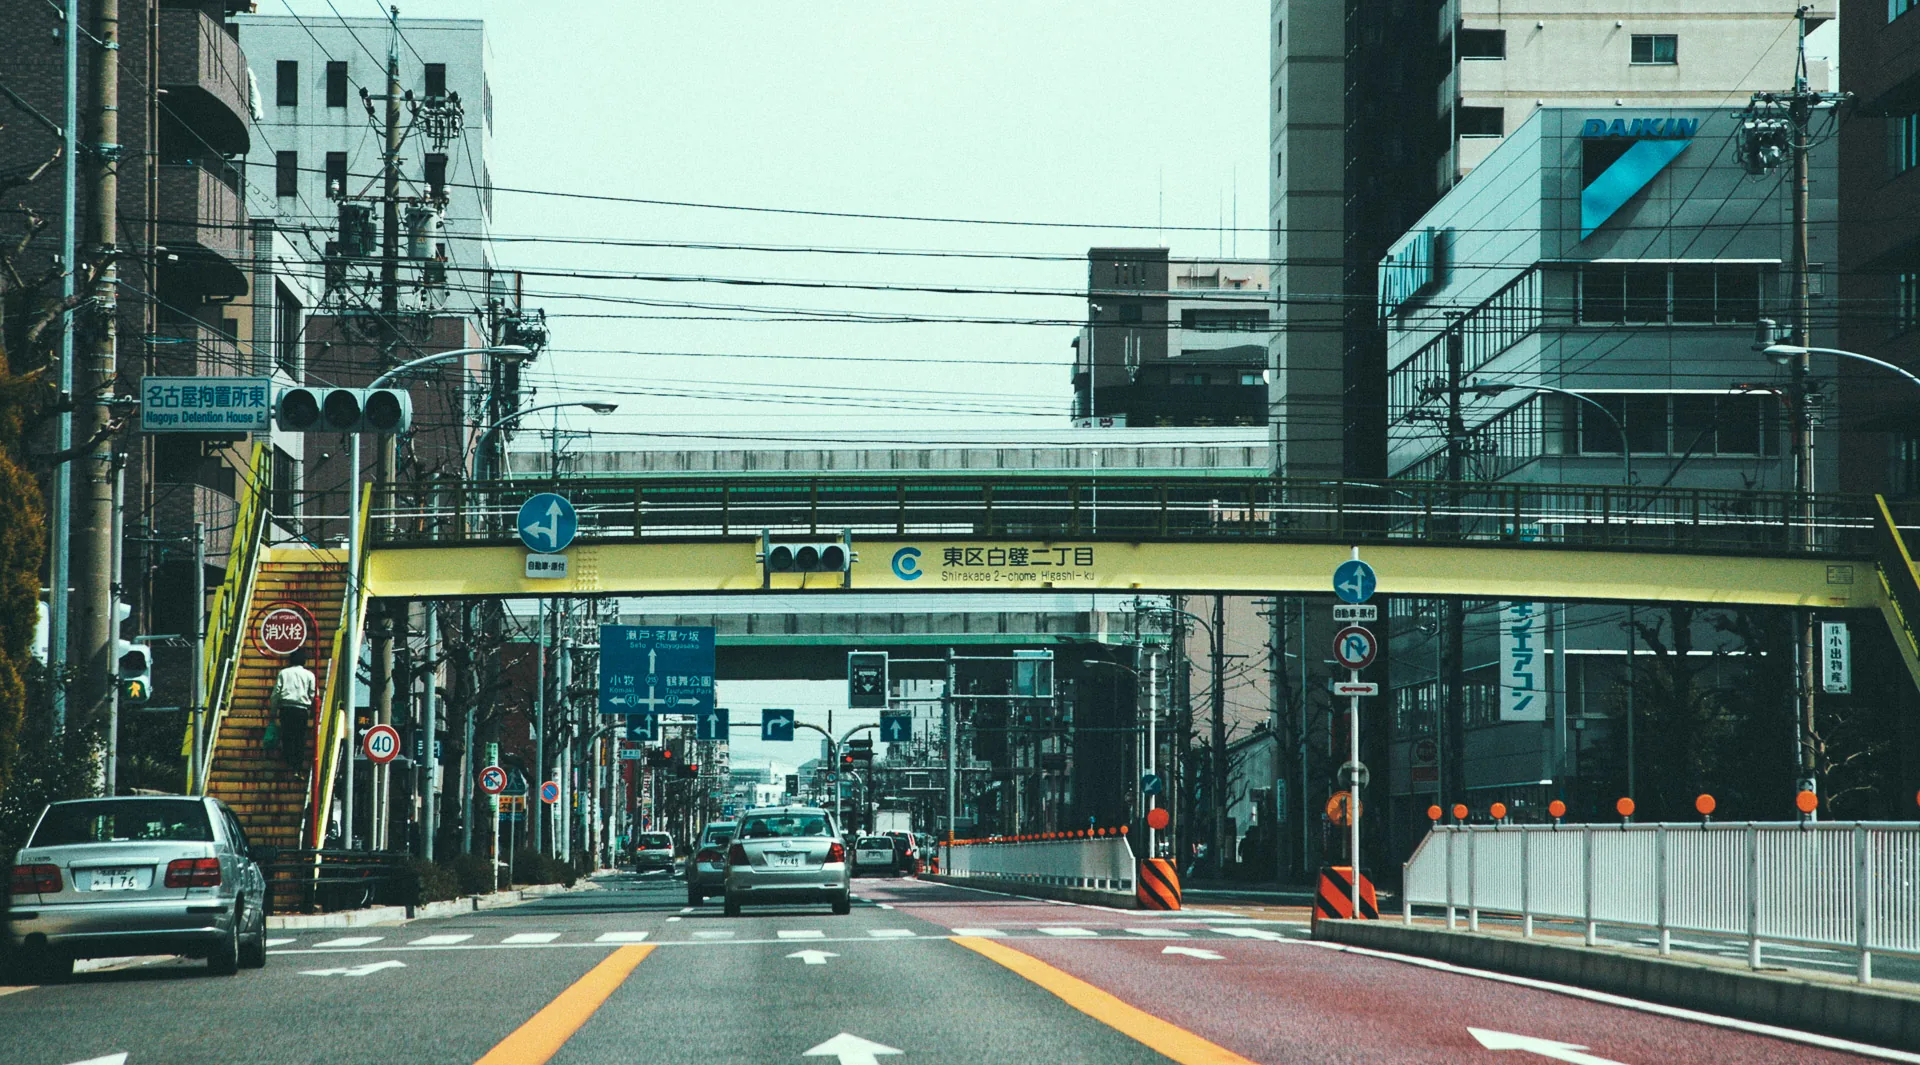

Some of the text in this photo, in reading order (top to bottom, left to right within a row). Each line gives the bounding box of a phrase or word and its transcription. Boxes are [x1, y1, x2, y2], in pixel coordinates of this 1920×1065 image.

[1582, 118, 1699, 137] DAIKIN
[146, 385, 266, 408] 名古屋拘置所東
[146, 411, 180, 425] Nagoya
[182, 410, 224, 423] Detention
[226, 411, 254, 423] House
[942, 547, 1094, 567] 東区白壁二丁目
[941, 570, 991, 581] Shirakabe
[993, 570, 1037, 581] 2-chome
[265, 623, 303, 640] 消火栓
[609, 675, 635, 686] 小牧
[667, 696, 676, 704] 41
[371, 736, 392, 753] 40
